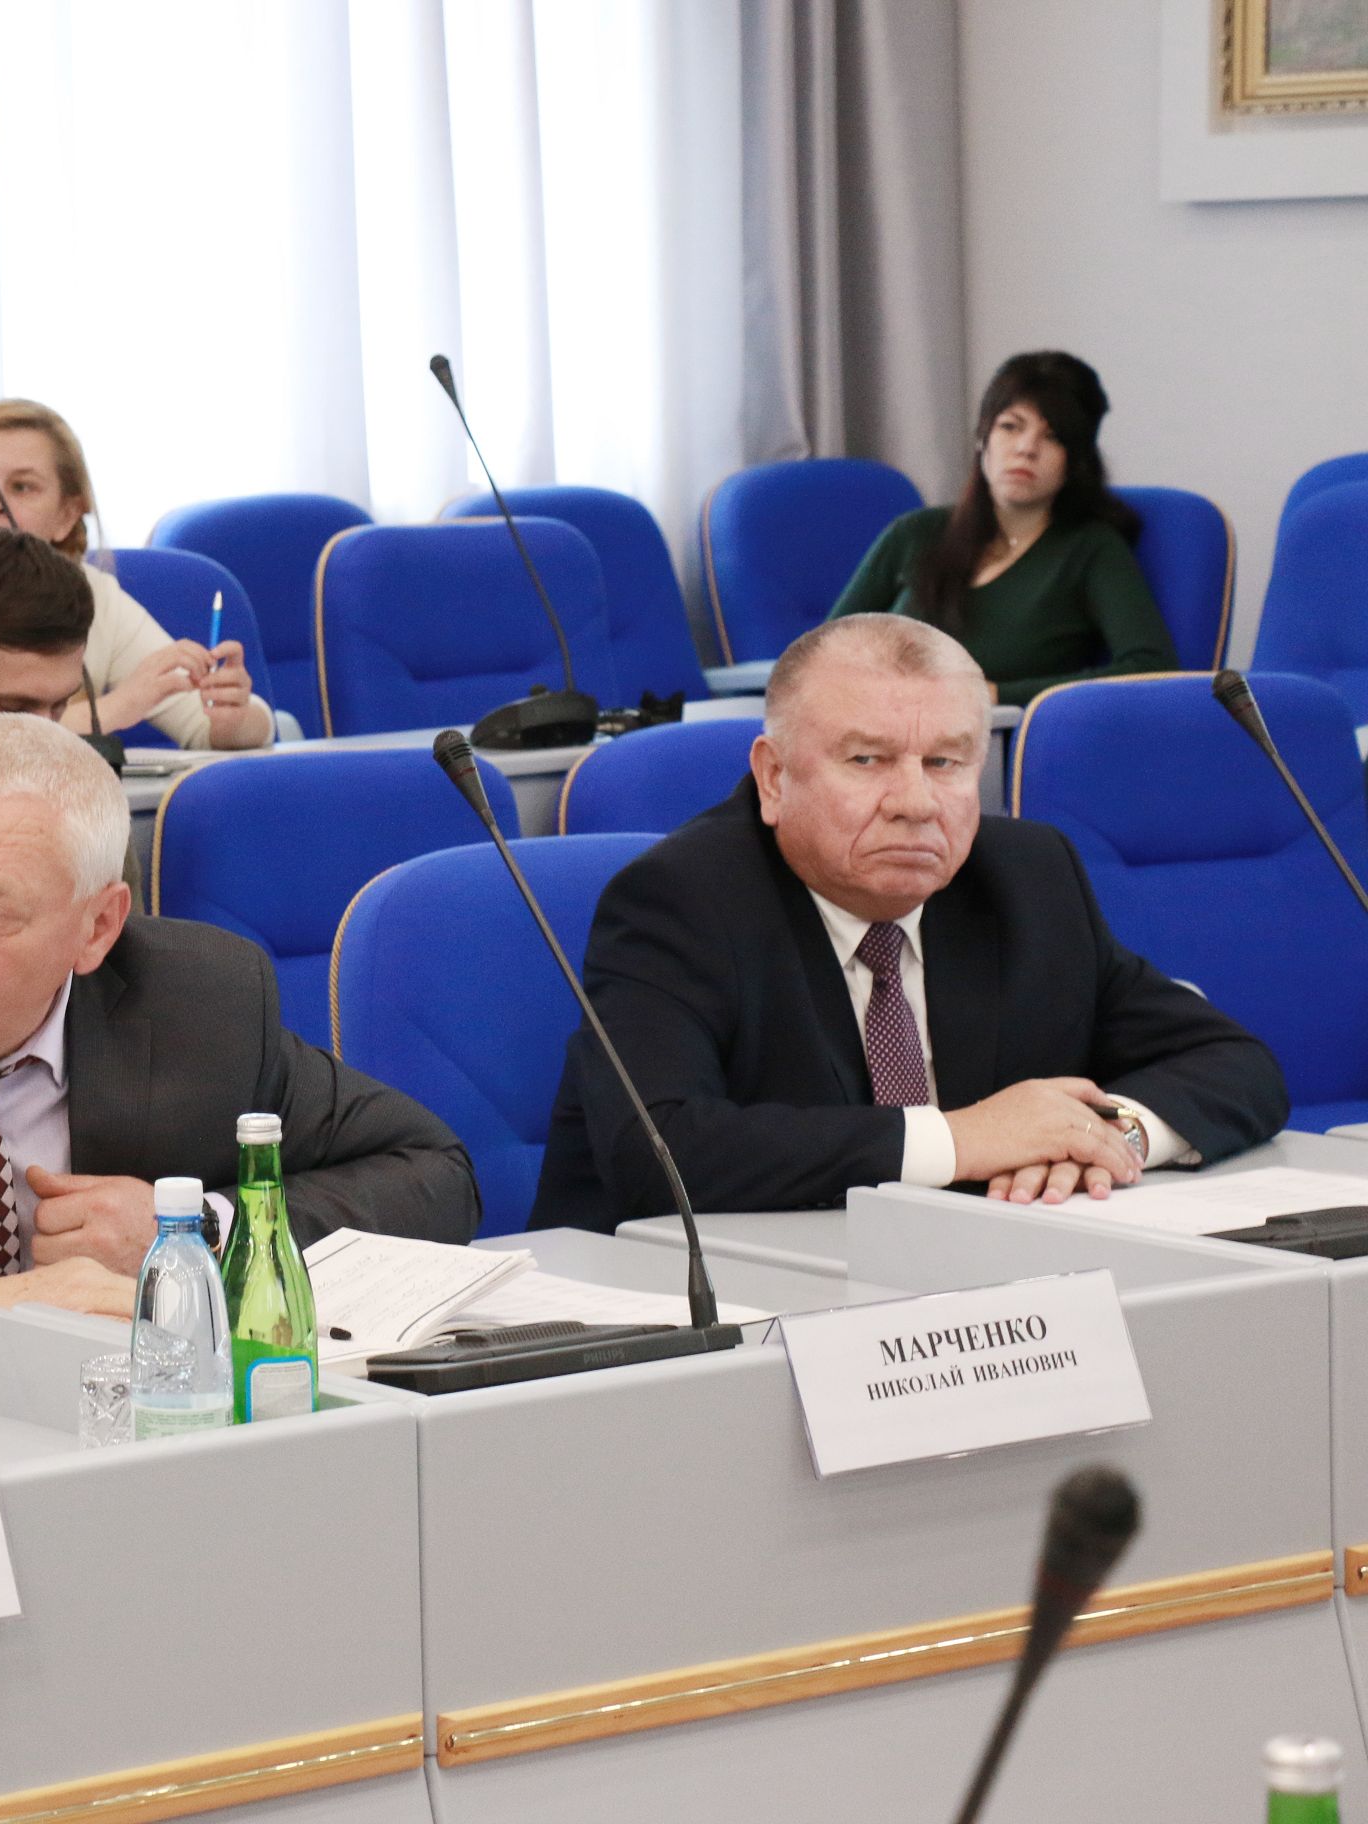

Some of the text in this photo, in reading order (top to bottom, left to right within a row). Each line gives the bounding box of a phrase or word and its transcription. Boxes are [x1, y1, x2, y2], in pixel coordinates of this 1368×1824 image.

[878, 1313, 1048, 1366] МАРЧЕНКО
[866, 1350, 1078, 1401] НИКОЛАЙ ИВАНОВИЧ
